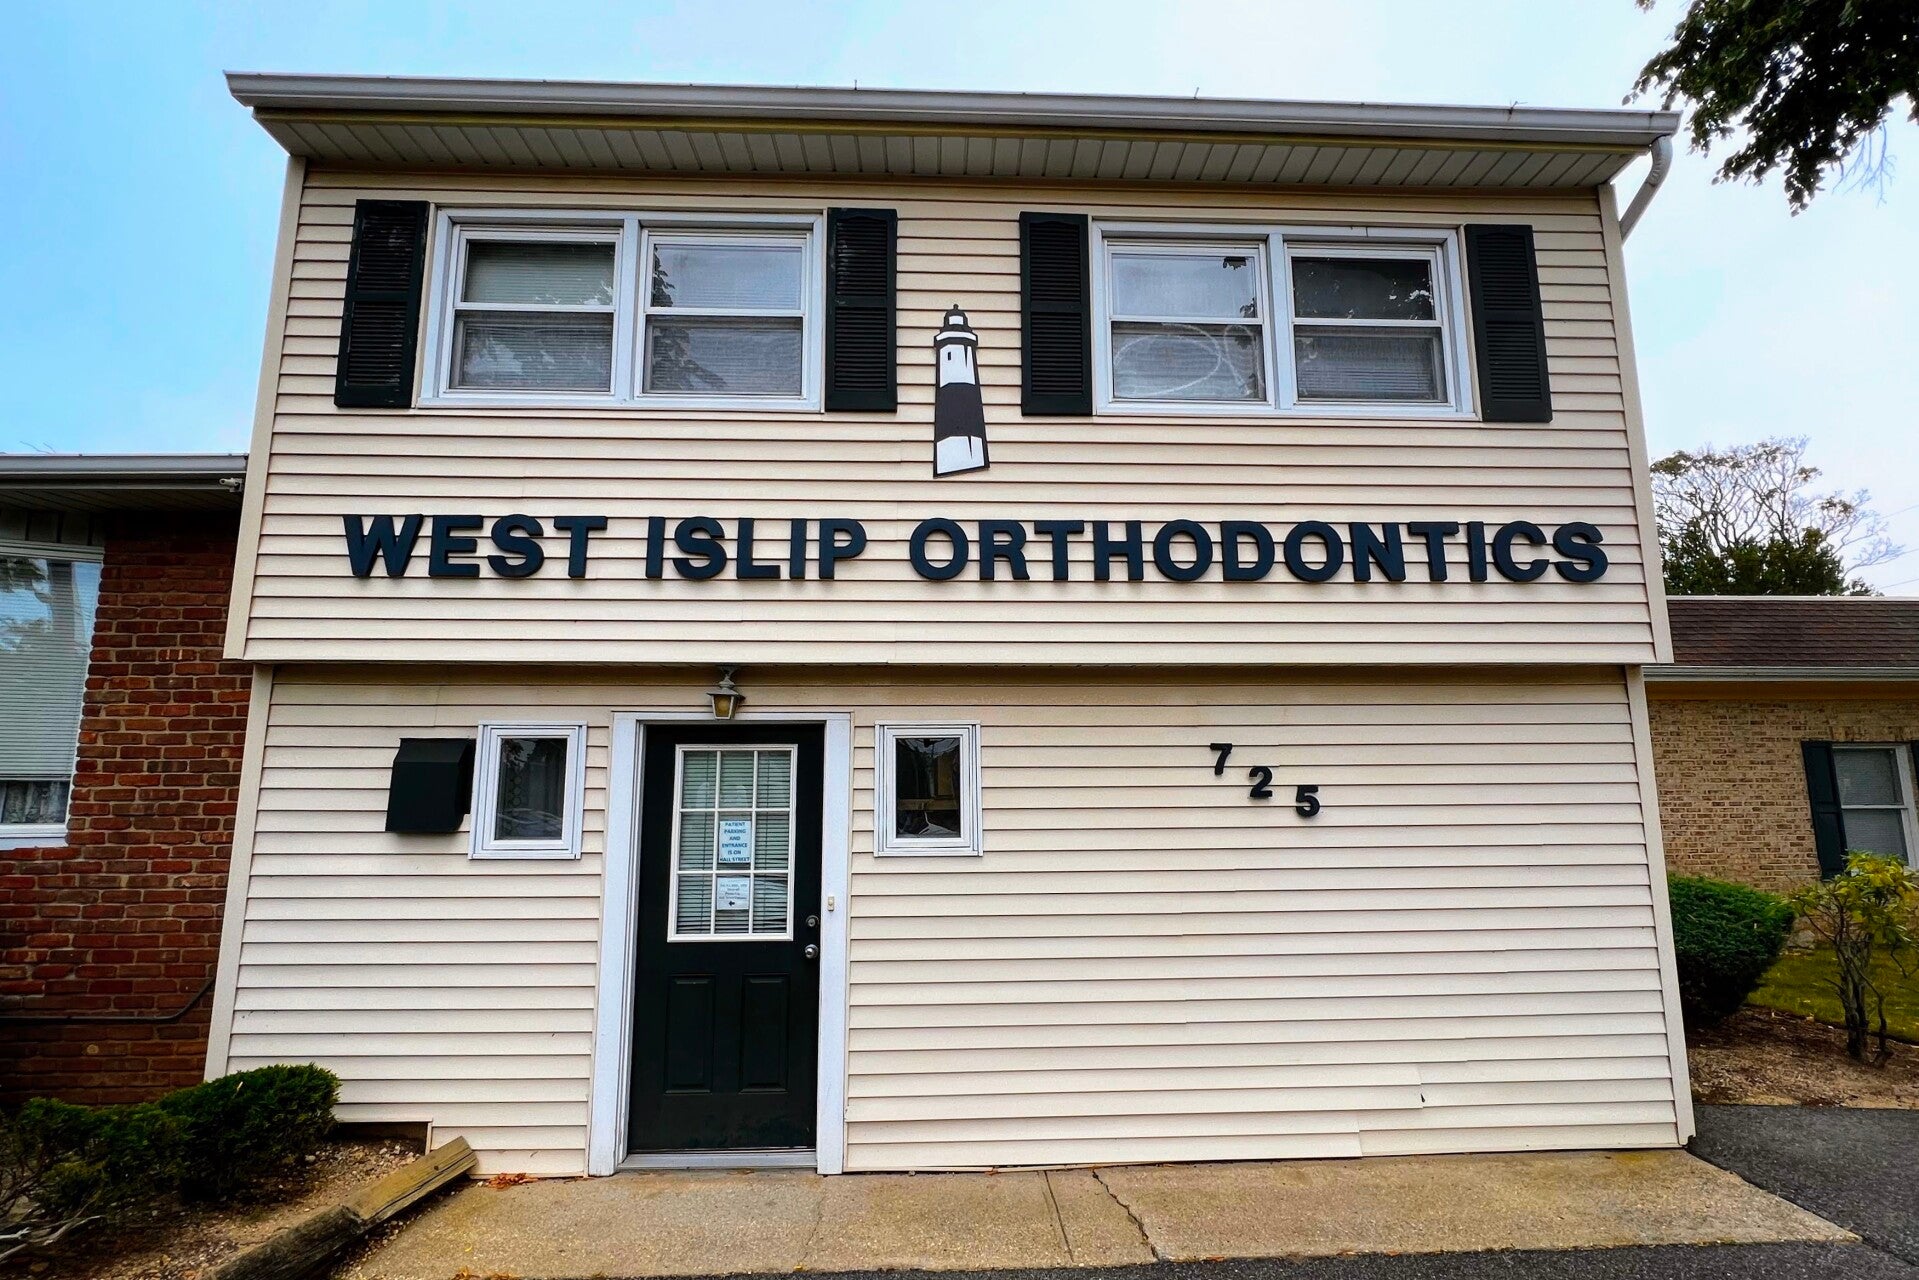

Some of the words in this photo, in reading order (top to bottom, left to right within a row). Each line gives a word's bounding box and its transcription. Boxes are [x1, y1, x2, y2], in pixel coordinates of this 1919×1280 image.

[343, 513, 608, 578] WEST
[645, 516, 867, 580] ISLIP
[909, 518, 1608, 583] ORTHODONTICS
[1209, 743, 1320, 817] 725
